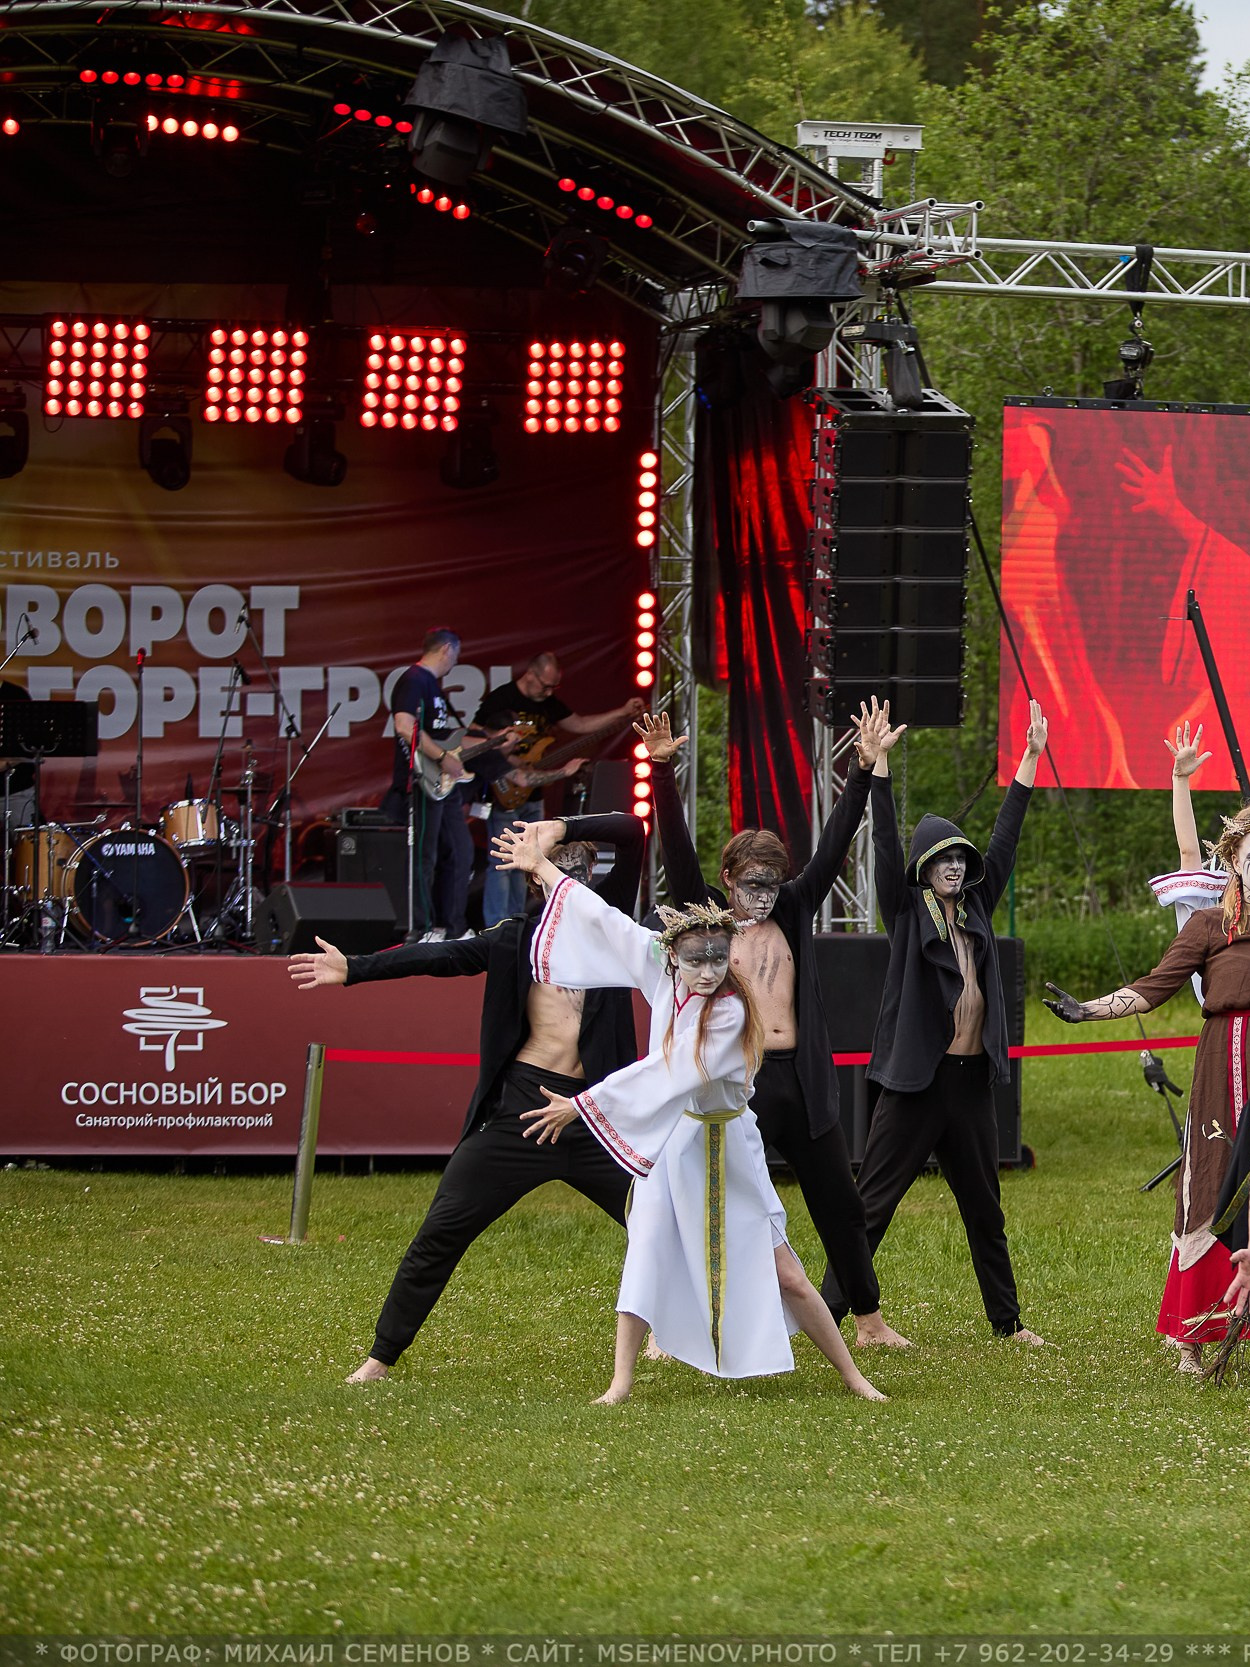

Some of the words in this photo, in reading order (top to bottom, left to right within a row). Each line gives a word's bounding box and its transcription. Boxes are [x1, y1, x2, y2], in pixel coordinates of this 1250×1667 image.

[0, 583, 300, 659] ВОРОТ
[27, 665, 513, 739] ГОРЕ-ГРЗ
[114, 842, 156, 857] YAMAHA
[60, 1076, 223, 1106] СОСНОВЫЙ
[230, 1081, 288, 1106] БОР
[75, 1112, 274, 1130] Санаторий-профилакторий
